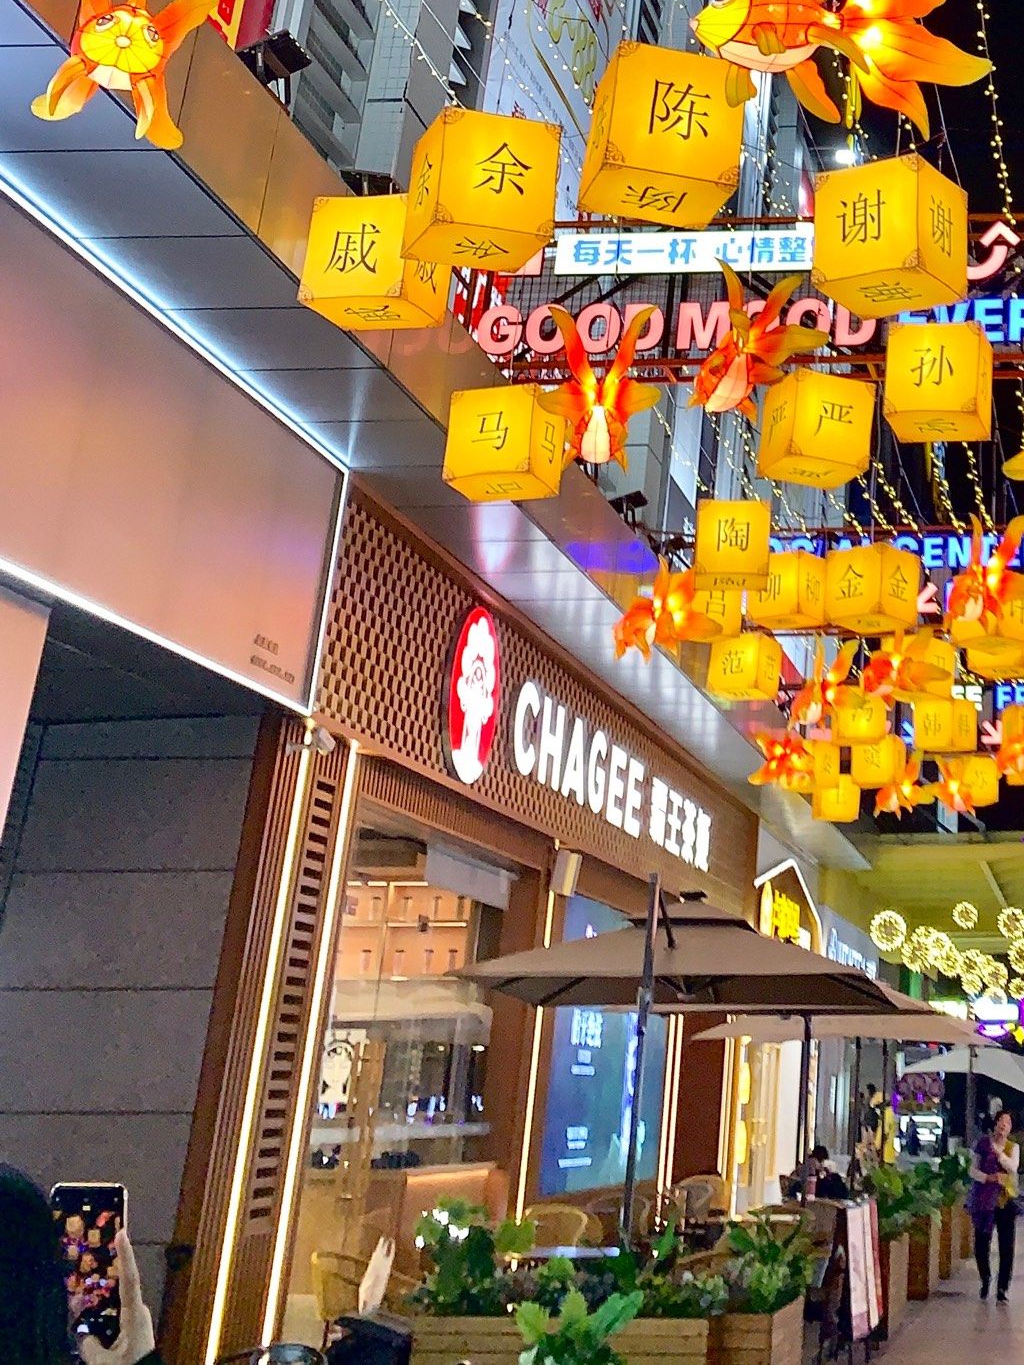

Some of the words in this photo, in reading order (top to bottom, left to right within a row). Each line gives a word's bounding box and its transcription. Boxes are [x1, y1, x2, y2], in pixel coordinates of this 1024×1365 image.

[648, 78, 713, 141] 陈
[472, 141, 533, 197] 余
[836, 187, 887, 247] 谢
[928, 193, 955, 261] 谢
[573, 237, 698, 266] 每天一杯
[716, 237, 814, 264] 心情整
[478, 302, 665, 355] GOOD
[910, 344, 955, 390] 孙
[471, 410, 510, 451] 马
[814, 399, 855, 437] 严
[716, 518, 752, 553] 陶
[834, 563, 865, 602] 金
[886, 563, 910, 603] 金
[513, 681, 645, 839] CHAGEE
